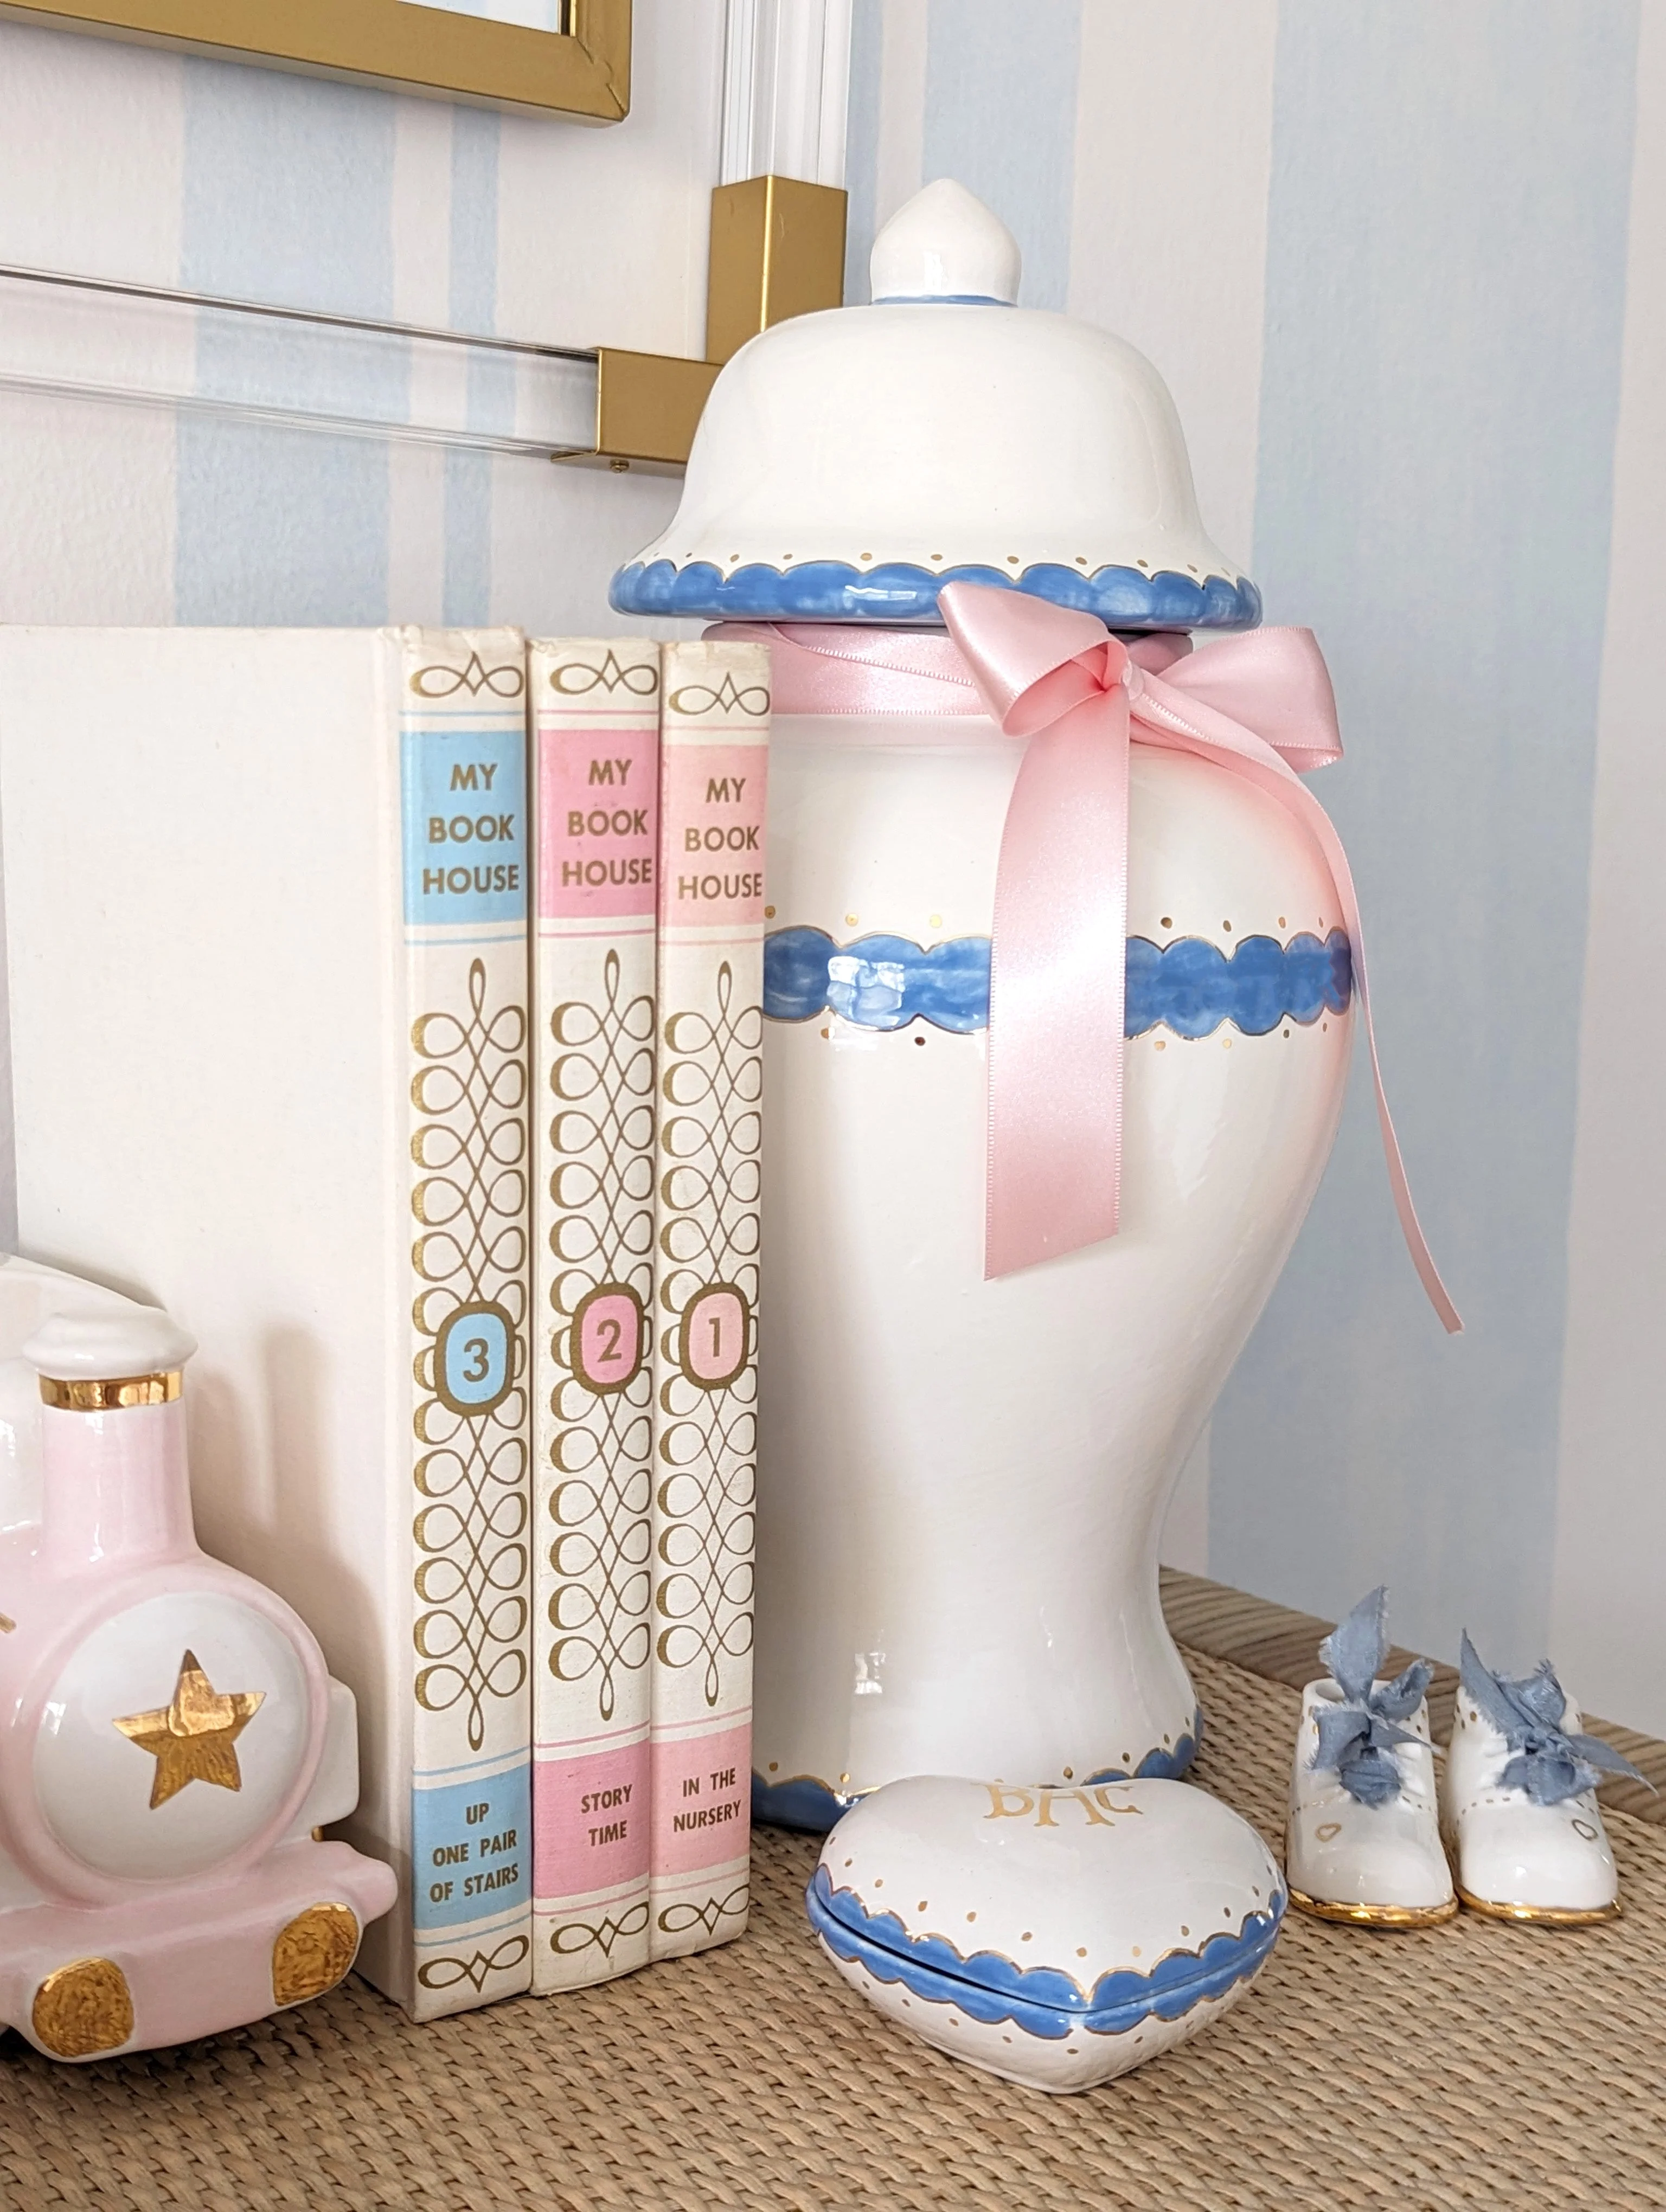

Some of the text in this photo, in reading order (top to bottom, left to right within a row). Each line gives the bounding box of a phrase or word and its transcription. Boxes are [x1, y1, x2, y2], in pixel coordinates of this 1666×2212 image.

[450, 762, 498, 791] MY
[588, 759, 632, 786] MY
[706, 777, 746, 802] MY
[428, 814, 515, 843] BOOK
[567, 809, 648, 837] BOOK
[684, 826, 760, 852] BOOK
[423, 865, 520, 895] HOUSE
[562, 858, 652, 887] HOUSE
[677, 873, 762, 900] HOUSE
[597, 1319, 622, 1362] 2
[708, 1317, 721, 1358] 1
[463, 1338, 489, 1382] 3
[683, 1767, 736, 1797] IN THE
[466, 1802, 490, 1825] UP
[581, 1784, 633, 1814] STORY
[673, 1799, 741, 1832] NURSERY
[432, 1829, 518, 1867] ONE PAIR
[588, 1821, 628, 1847] TIME
[430, 1863, 518, 1903] OF STAIRS
